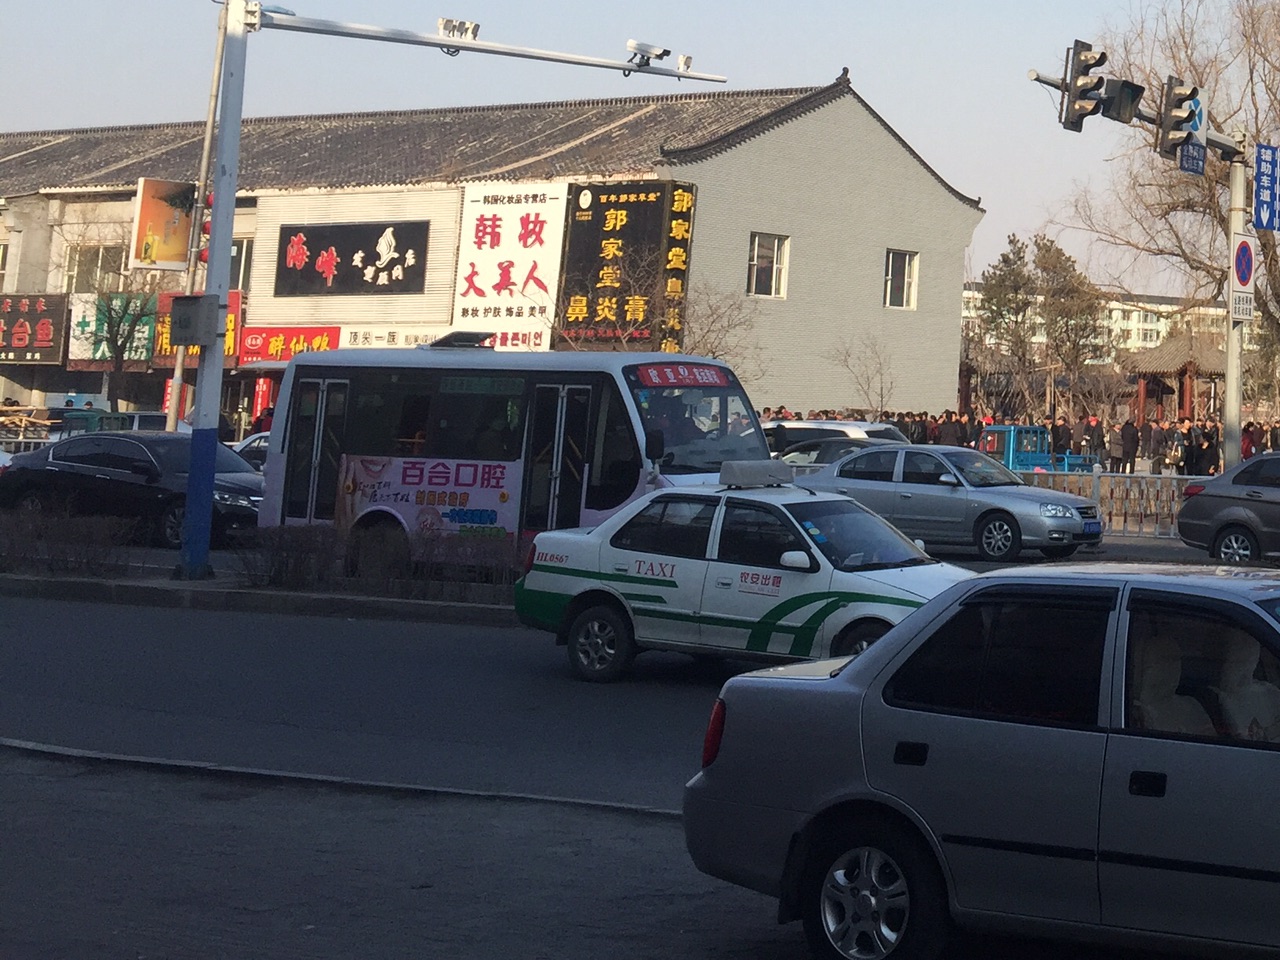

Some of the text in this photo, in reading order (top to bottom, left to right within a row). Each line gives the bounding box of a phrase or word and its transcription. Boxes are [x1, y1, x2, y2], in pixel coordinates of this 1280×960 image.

[1260, 148, 1272, 202] 辅助车道
[483, 193, 547, 205] 韩国化妆品专营店
[473, 213, 547, 250] 韩妆
[596, 208, 627, 288] 郭家堂
[460, 260, 549, 298] 大美人
[483, 307, 501, 318] 护肤
[566, 294, 649, 322] 鼻炎膏
[349, 331, 398, 345] 顶尖一族
[401, 461, 507, 489] 百合口腔
[635, 559, 676, 578] TAXI
